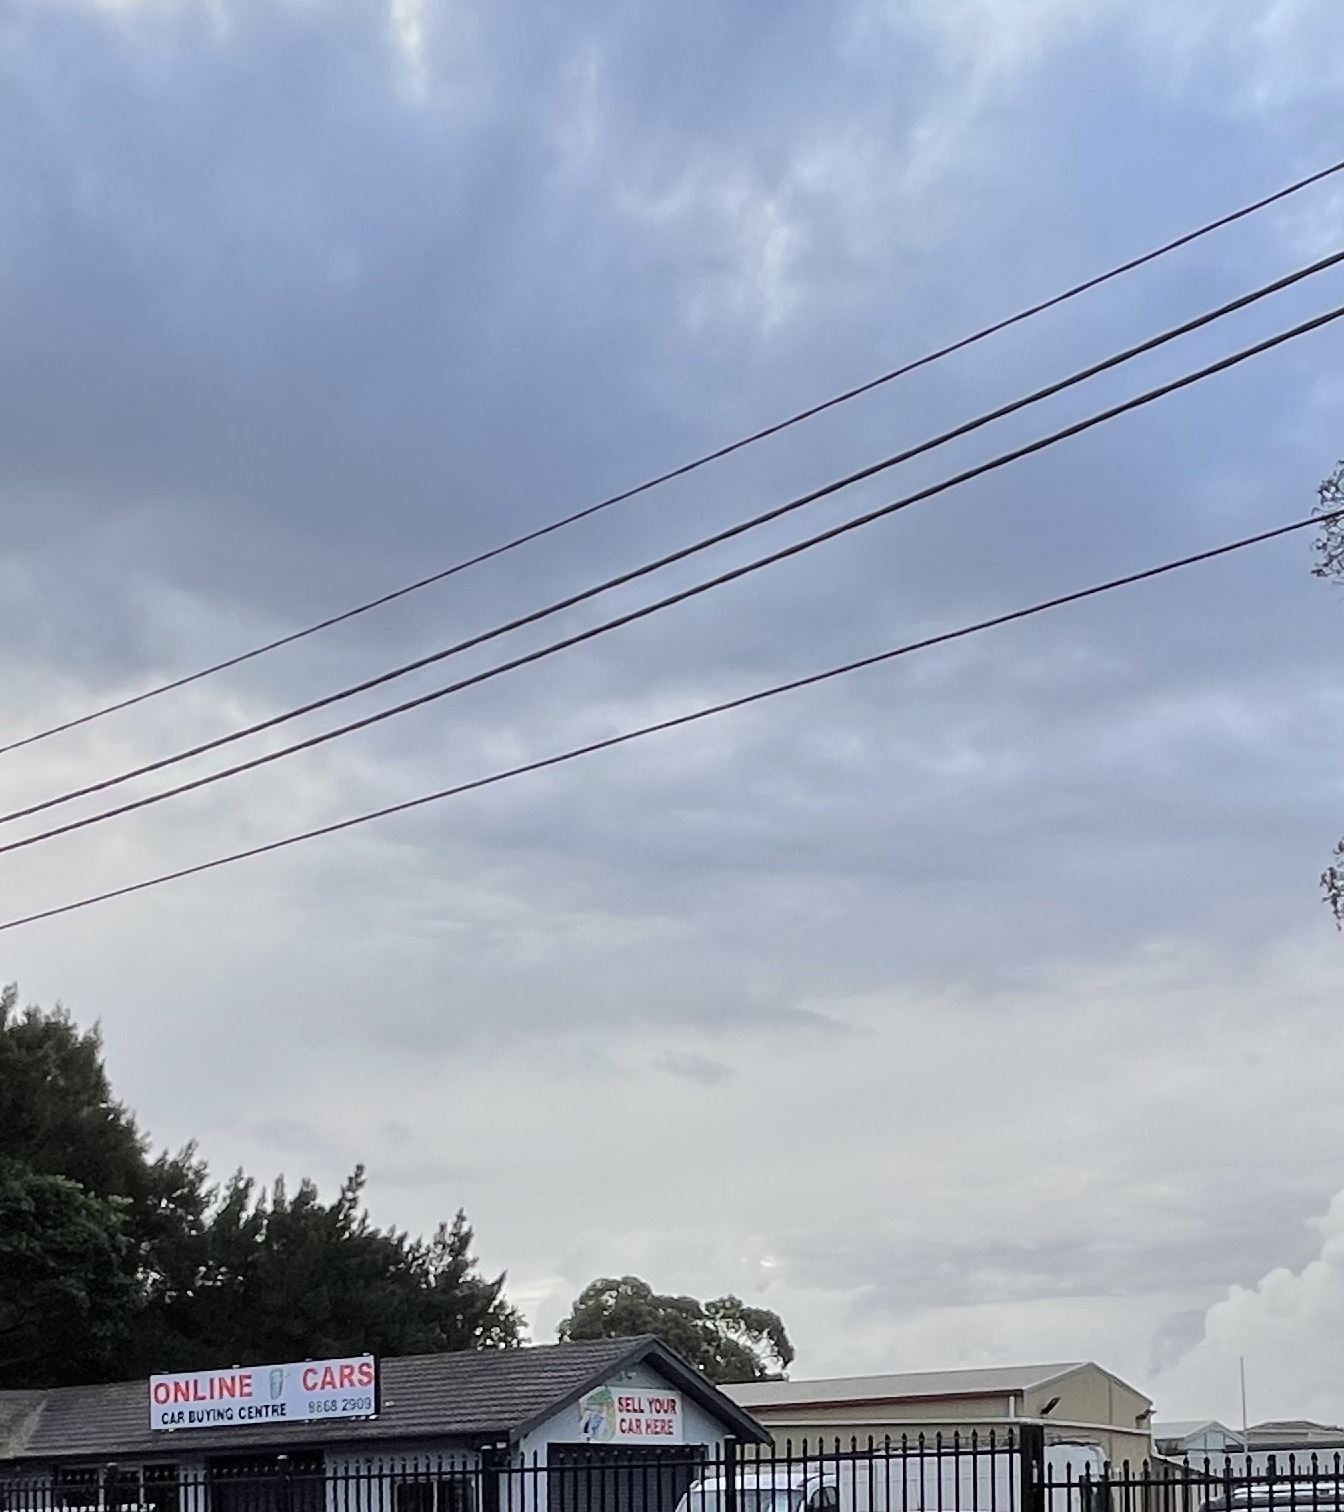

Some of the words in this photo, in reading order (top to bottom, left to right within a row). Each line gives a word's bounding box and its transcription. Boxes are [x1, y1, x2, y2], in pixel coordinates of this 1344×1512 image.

[153, 1374, 254, 1405] ONLINE
[302, 1362, 375, 1392] CARS
[161, 1411, 186, 1425] CAR
[189, 1407, 234, 1424] BUYING
[238, 1402, 287, 1420] CENTRE
[617, 1396, 645, 1414] SELL
[647, 1397, 678, 1415] YOUR
[619, 1418, 643, 1435] CAR
[645, 1419, 674, 1435] HERE
